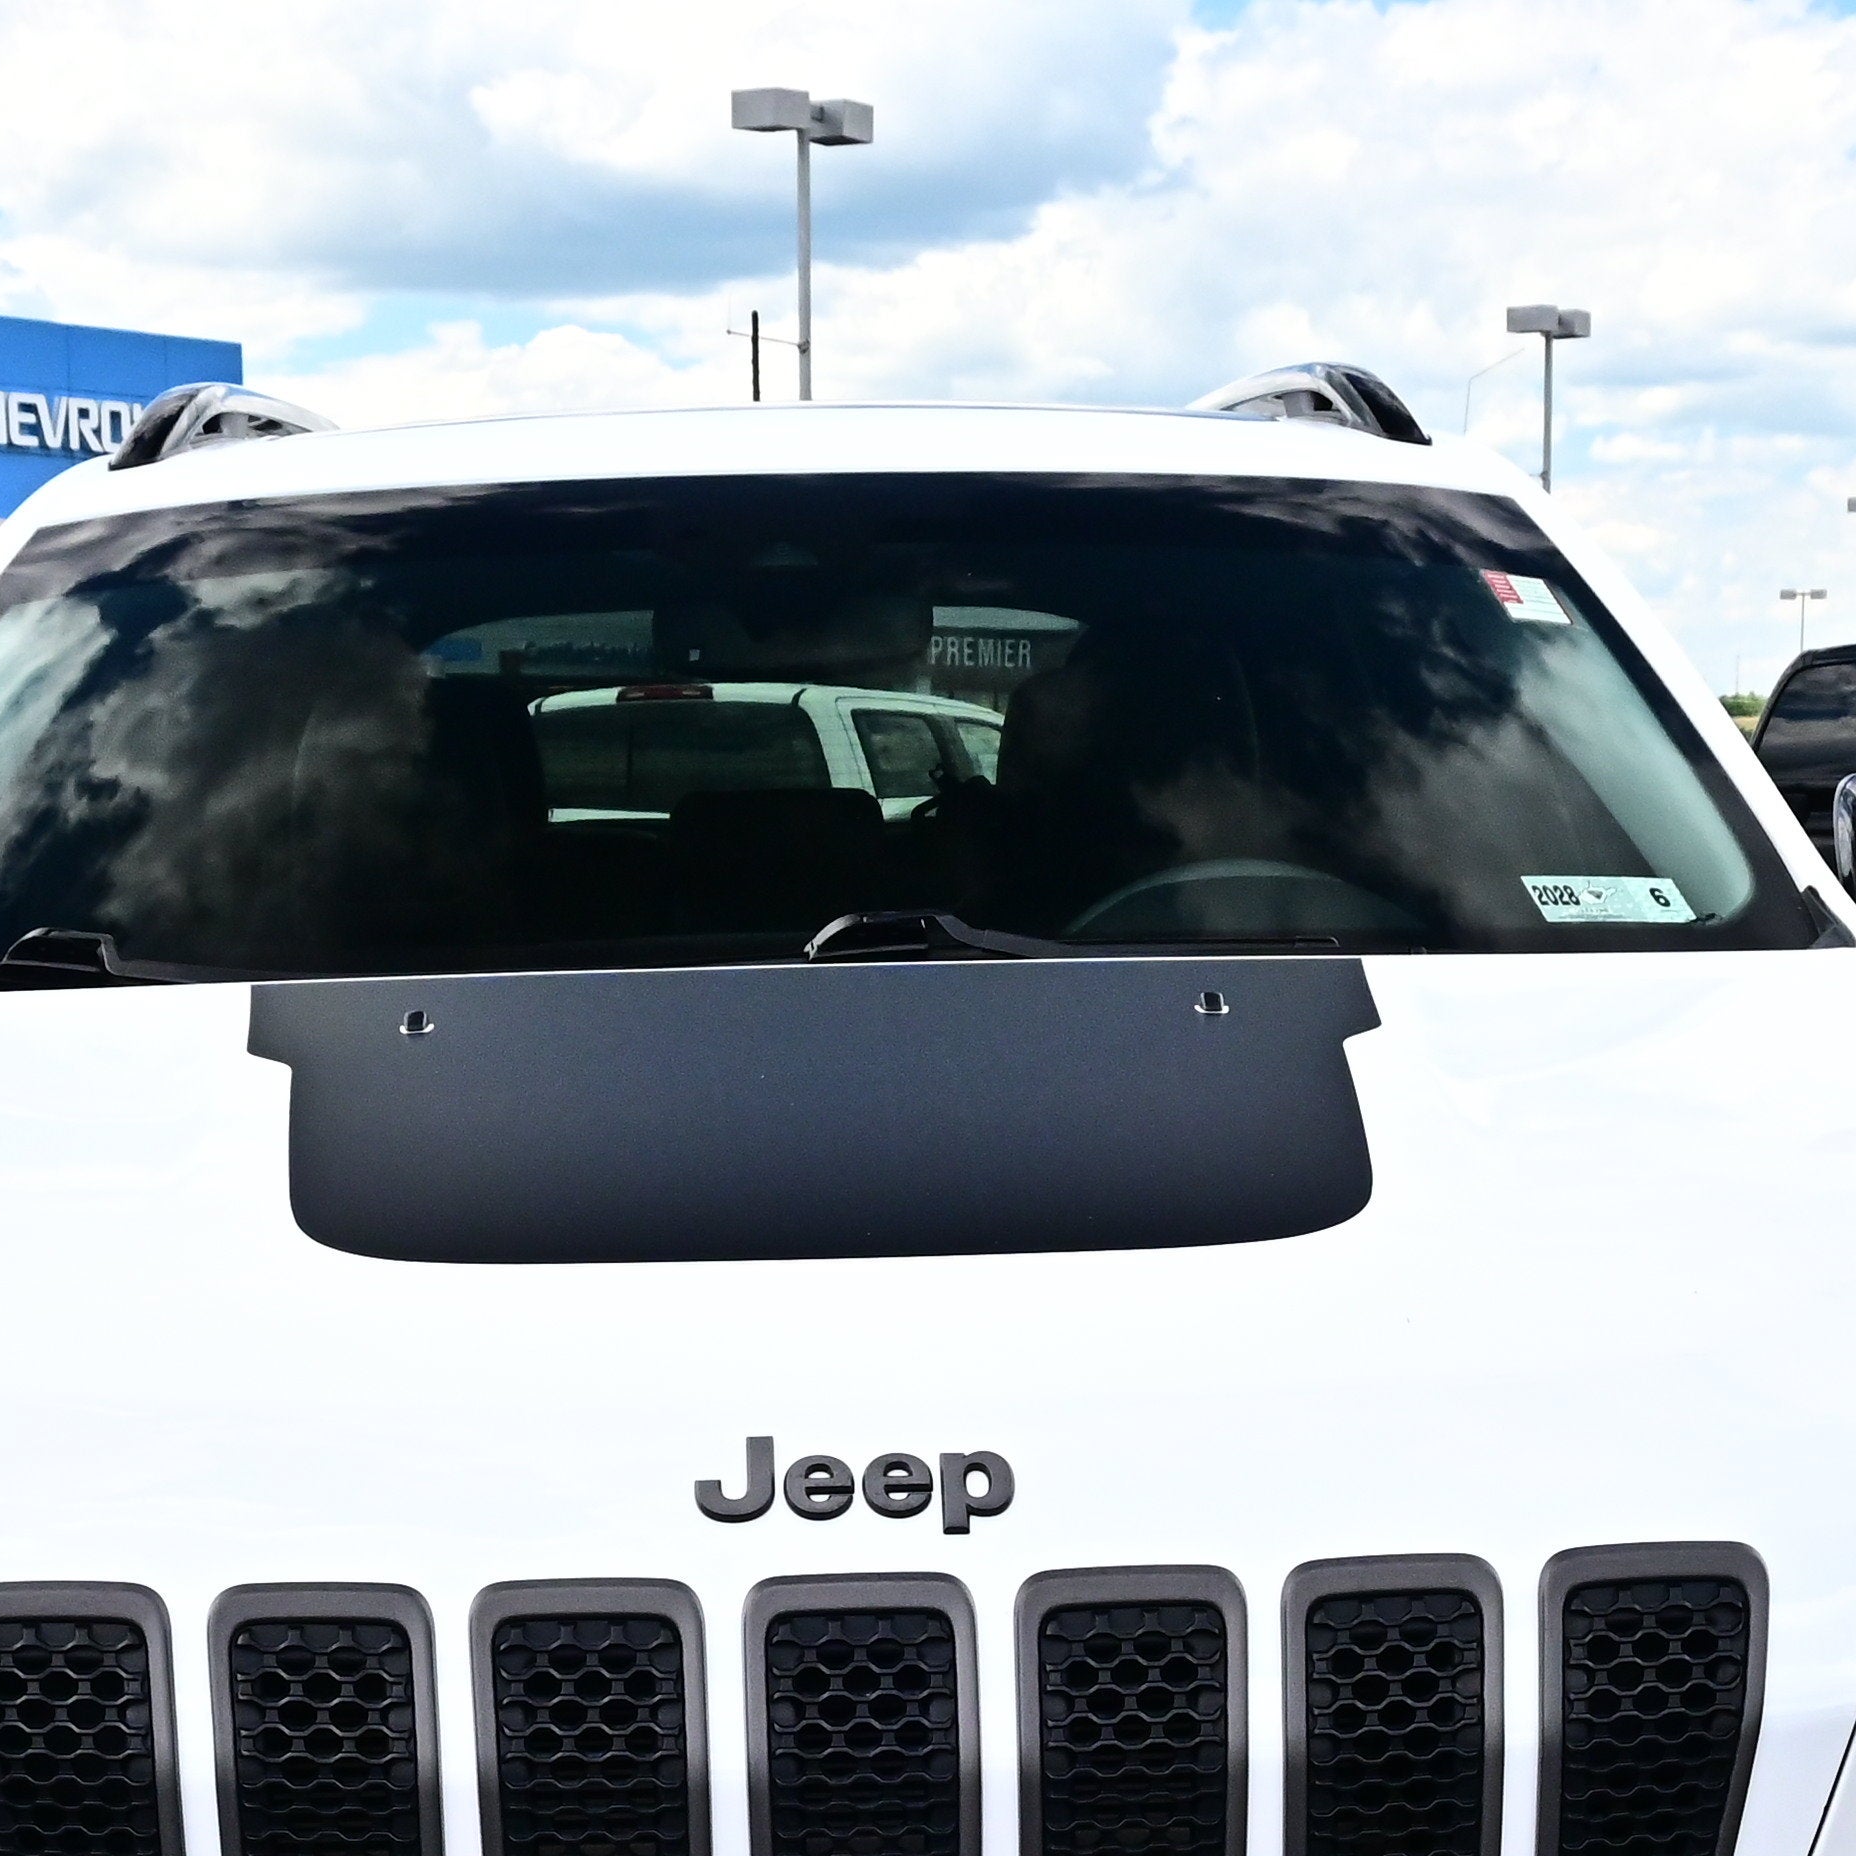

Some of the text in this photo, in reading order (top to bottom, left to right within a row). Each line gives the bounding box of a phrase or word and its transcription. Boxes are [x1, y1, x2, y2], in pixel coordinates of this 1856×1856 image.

[929, 635, 1032, 668] PREMIER
[1531, 884, 1671, 907] 2028 6
[694, 1435, 1015, 1535] Jeep
